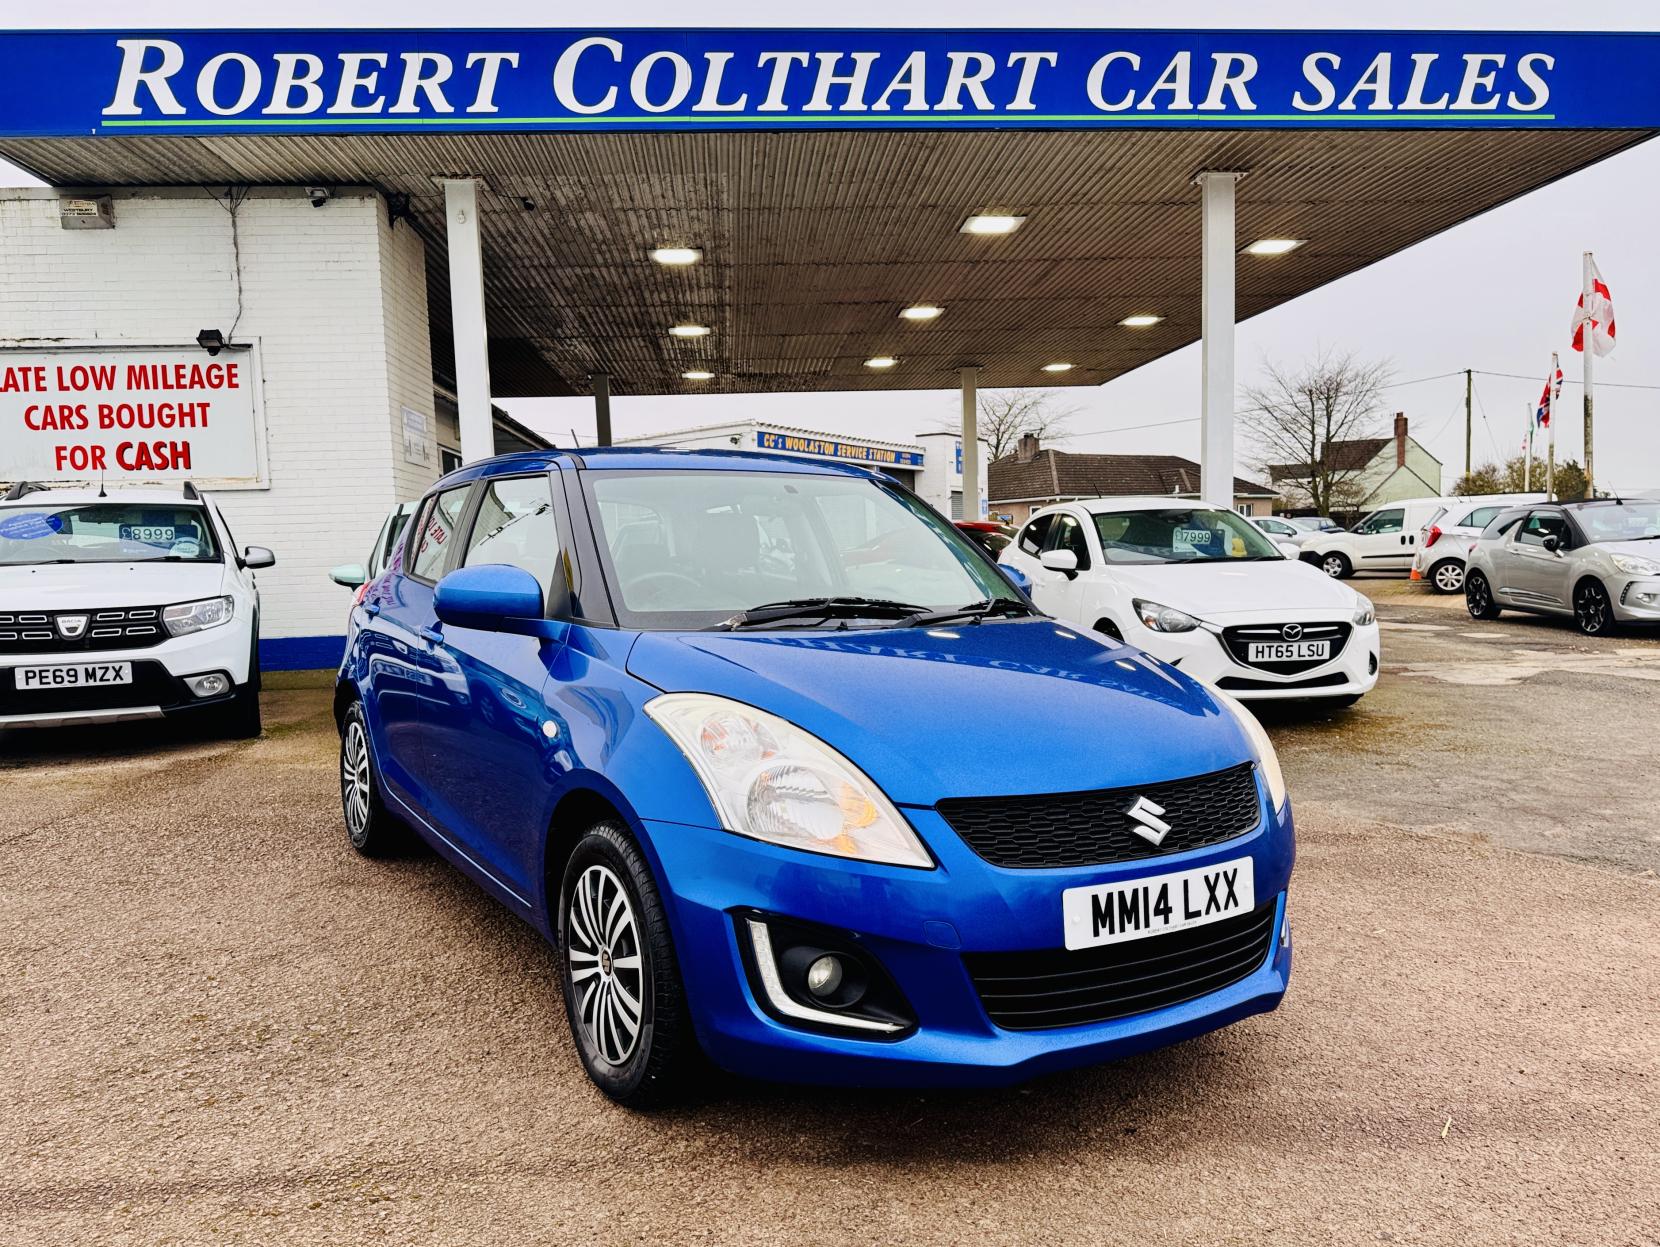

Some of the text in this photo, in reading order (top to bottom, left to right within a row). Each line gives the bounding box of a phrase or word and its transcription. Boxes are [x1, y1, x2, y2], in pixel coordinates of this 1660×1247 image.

[102, 36, 1555, 116] ROBERT COLTHART CAR SALES
[57, 365, 117, 392] LOW
[126, 363, 240, 391] MILEAGE
[24, 402, 210, 431] CARS BOUGHT
[55, 440, 192, 472] FOR CASH
[785, 436, 835, 456] WOOLASTON
[837, 443, 867, 461] SERVICE
[868, 447, 896, 463] STATION
[1255, 643, 1325, 659] HT65 LSU
[25, 665, 124, 686] PE69 MZX
[1091, 867, 1240, 938] MM14 LXX
